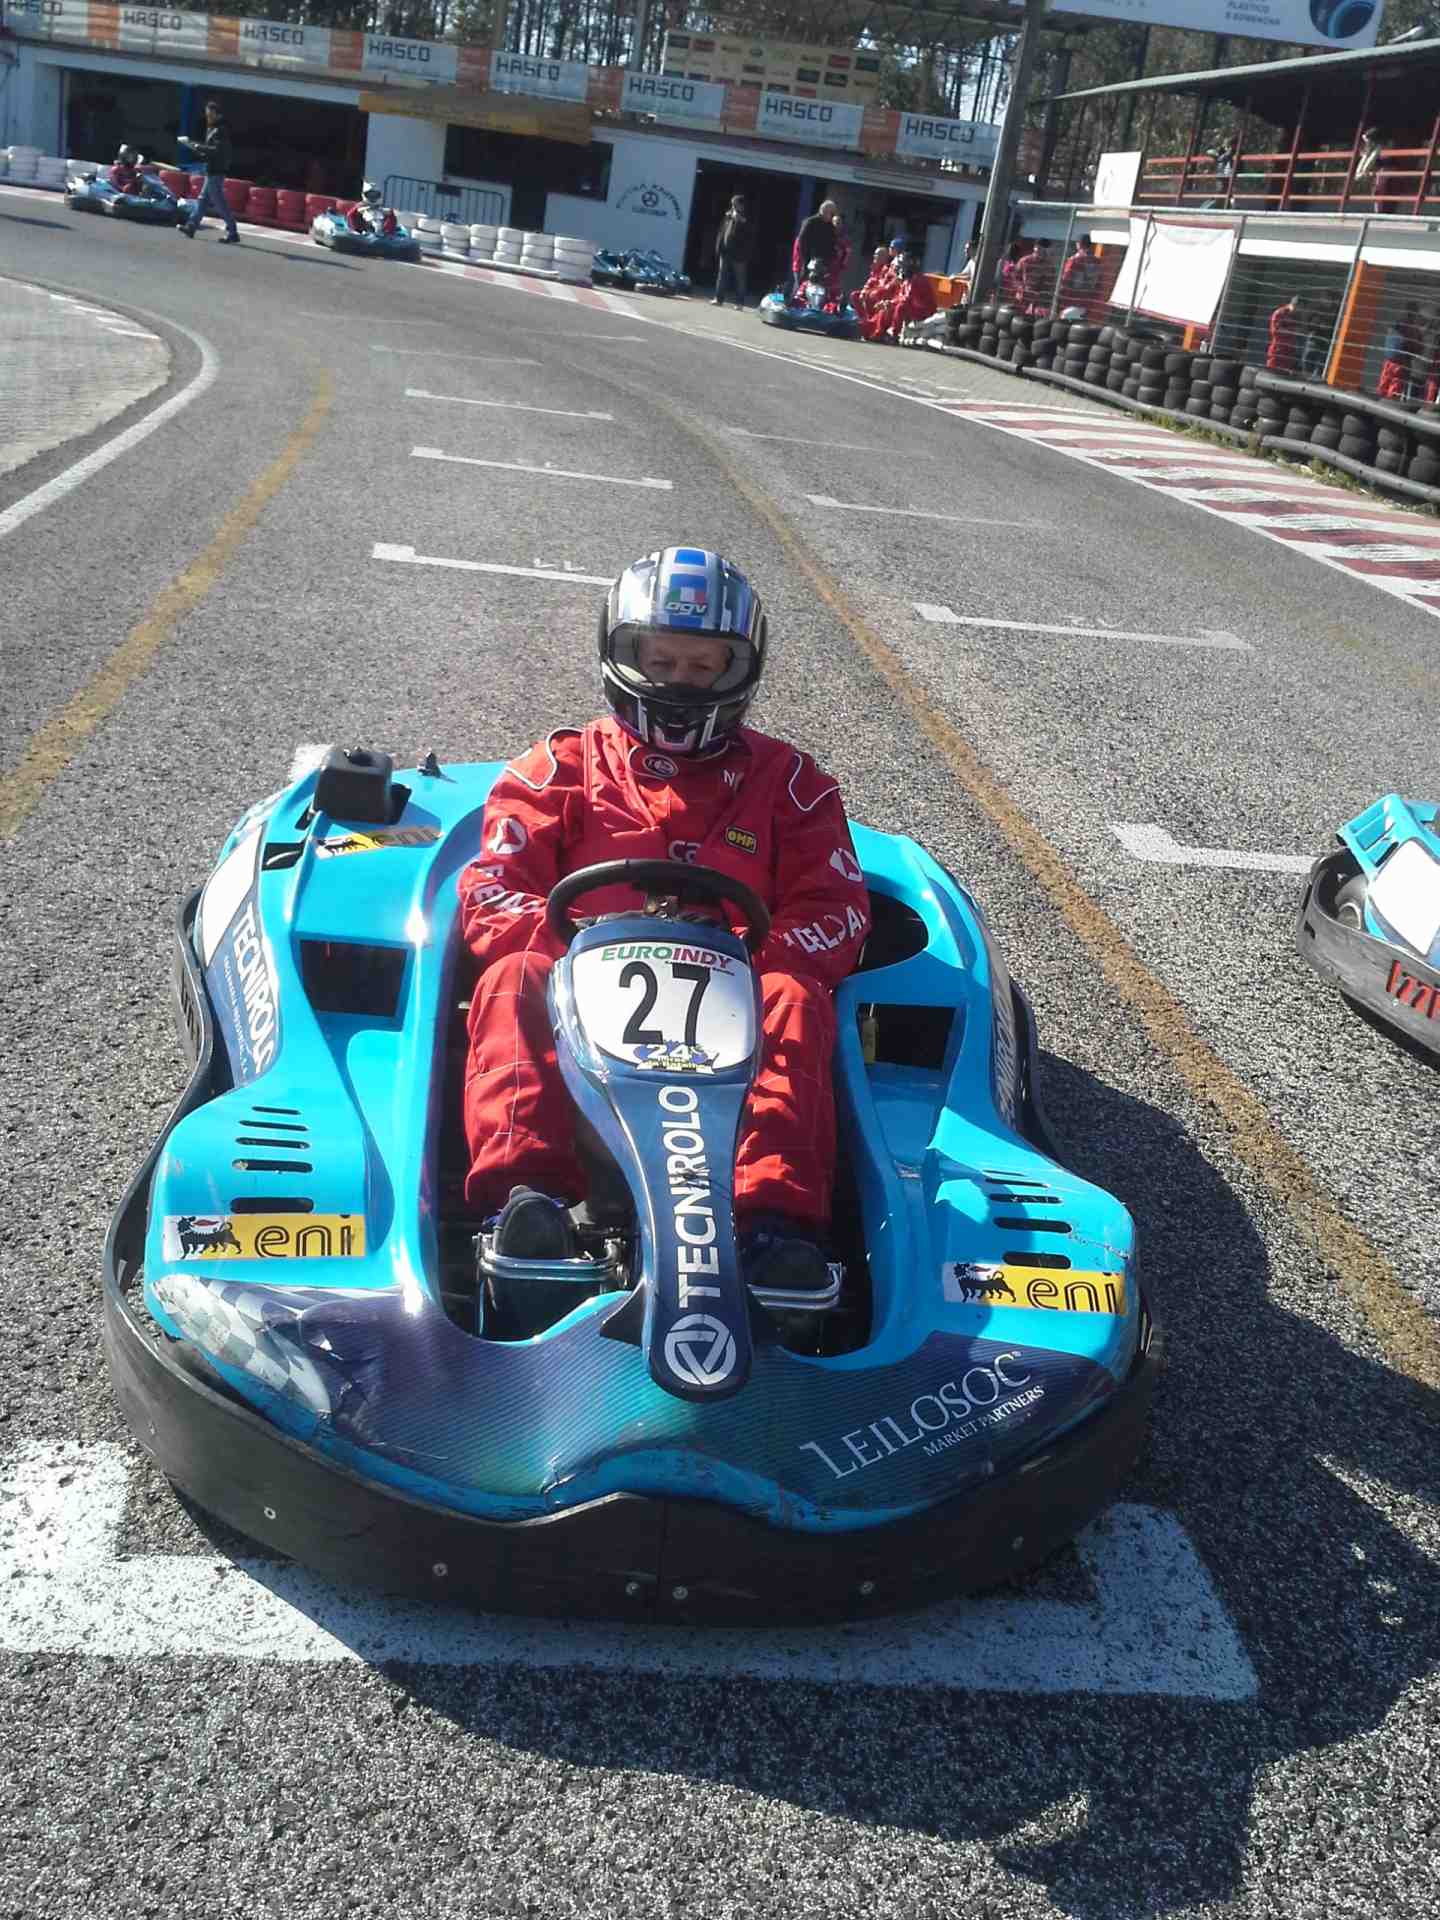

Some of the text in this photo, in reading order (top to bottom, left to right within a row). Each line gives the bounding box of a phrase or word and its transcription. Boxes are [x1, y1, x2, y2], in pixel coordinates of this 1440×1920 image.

[122, 9, 182, 31] HASCO
[244, 24, 304, 46] HASCO
[368, 38, 431, 63] HASCO
[496, 55, 560, 82] HASCO
[629, 75, 695, 102] HASCO
[765, 97, 833, 122] HASCO
[905, 118, 976, 144] HASCO
[602, 946, 733, 969] EUROINDY
[618, 960, 712, 1046] 27
[254, 1214, 353, 1259] eni
[1026, 1271, 1121, 1314] eni
[799, 1350, 1032, 1480] LEILOSOC
[922, 1384, 1046, 1457] MARKET PARTNERS
